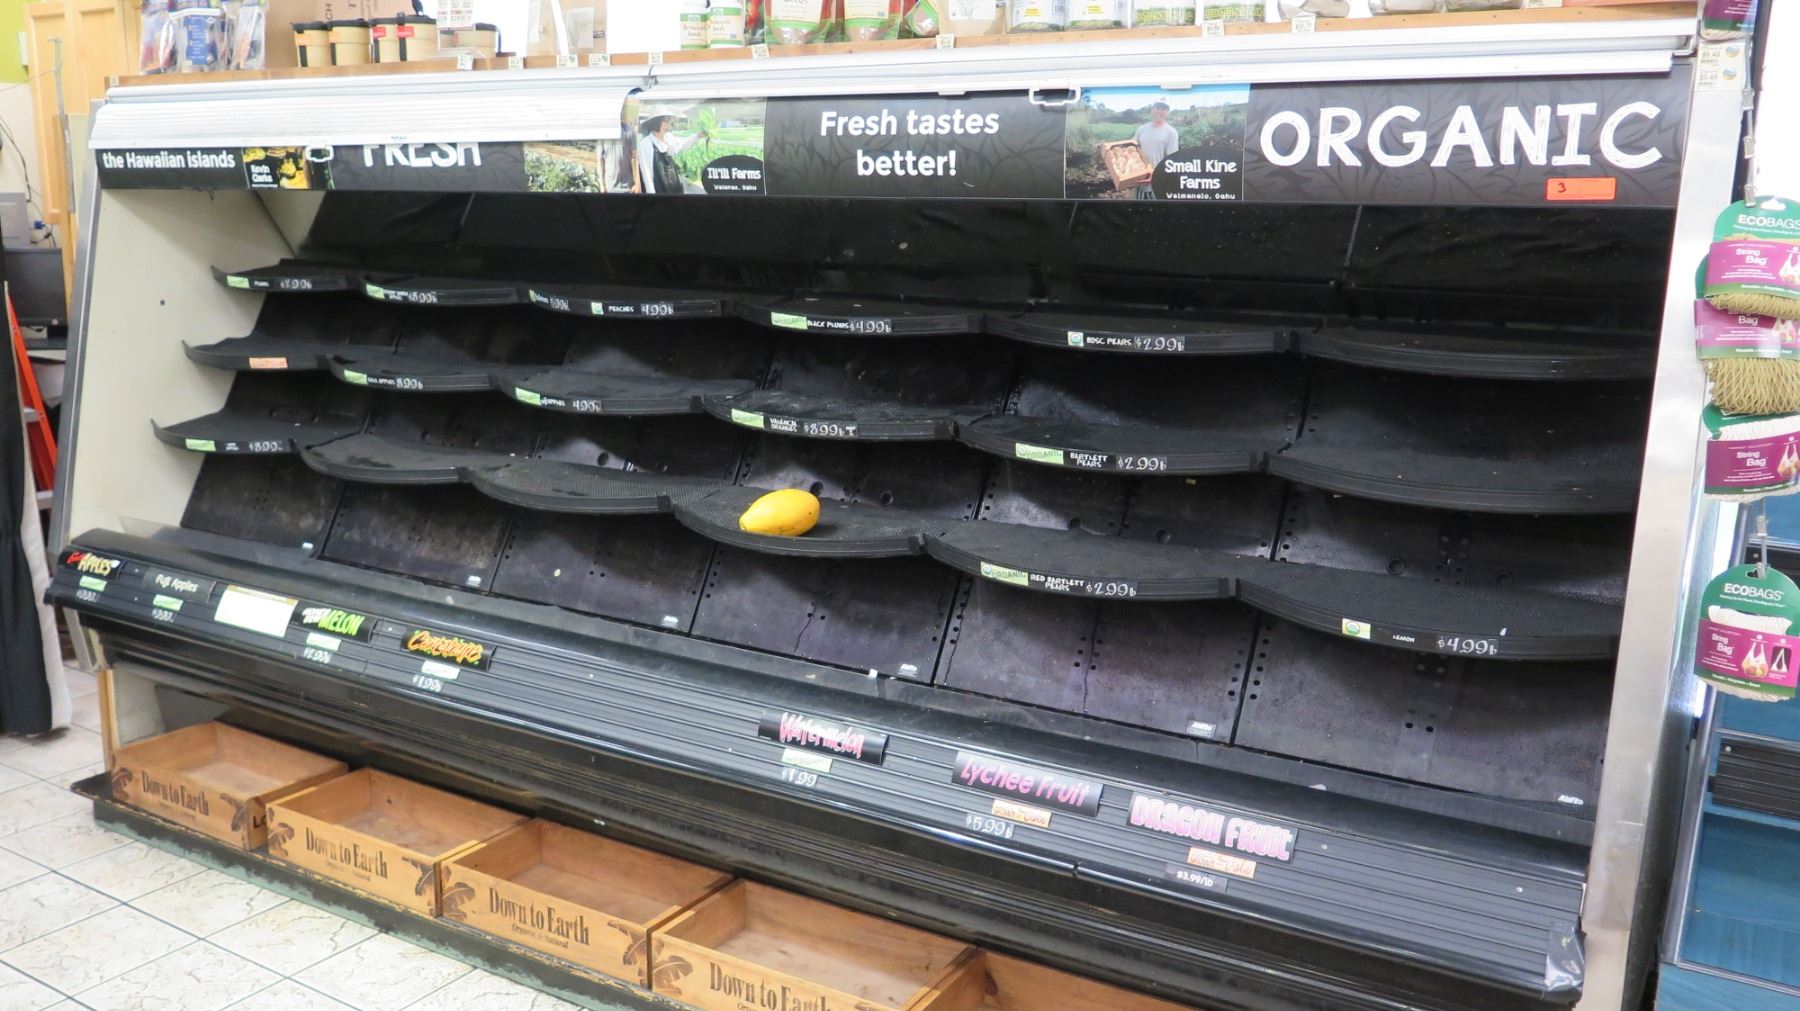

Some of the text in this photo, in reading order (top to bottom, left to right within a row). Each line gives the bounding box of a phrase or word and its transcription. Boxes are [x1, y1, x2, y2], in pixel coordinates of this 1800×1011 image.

[820, 109, 999, 136] Fresh tastes
[1260, 101, 1663, 169] ORGANIC
[102, 151, 124, 168] the
[126, 151, 185, 168] Hawaiian
[856, 150, 957, 176] better!
[1164, 159, 1237, 173] Small Kine
[731, 167, 762, 180] Farms
[1180, 175, 1221, 189] Farms
[1556, 181, 1567, 194] 3
[1738, 214, 1800, 230] ECOBAGS
[1735, 248, 1761, 257] String
[1745, 255, 1768, 266] Bag
[807, 320, 825, 328] BLACK
[1738, 315, 1759, 327] Bag
[1106, 337, 1132, 346] PEARS
[1070, 452, 1109, 463] BARTLETT
[1736, 451, 1761, 459] String
[1076, 459, 1103, 469] PEARS
[1746, 458, 1767, 467] Bag
[172, 577, 199, 593] Apples
[1030, 573, 1085, 588] RED BARTLETT
[1045, 581, 1071, 592] PEARS
[1723, 583, 1784, 602] ECOBAGS
[317, 609, 365, 637] MELON
[1711, 632, 1729, 645] String
[1716, 642, 1733, 656] Bag
[960, 757, 1091, 807] Lychee Fruit
[142, 770, 209, 816] Down to Earth
[1130, 796, 1226, 845] DRAGON
[305, 825, 388, 880] Down to Earth
[489, 886, 590, 946] Down to Earth
[709, 961, 756, 1005] Down
[759, 978, 778, 1011] to
